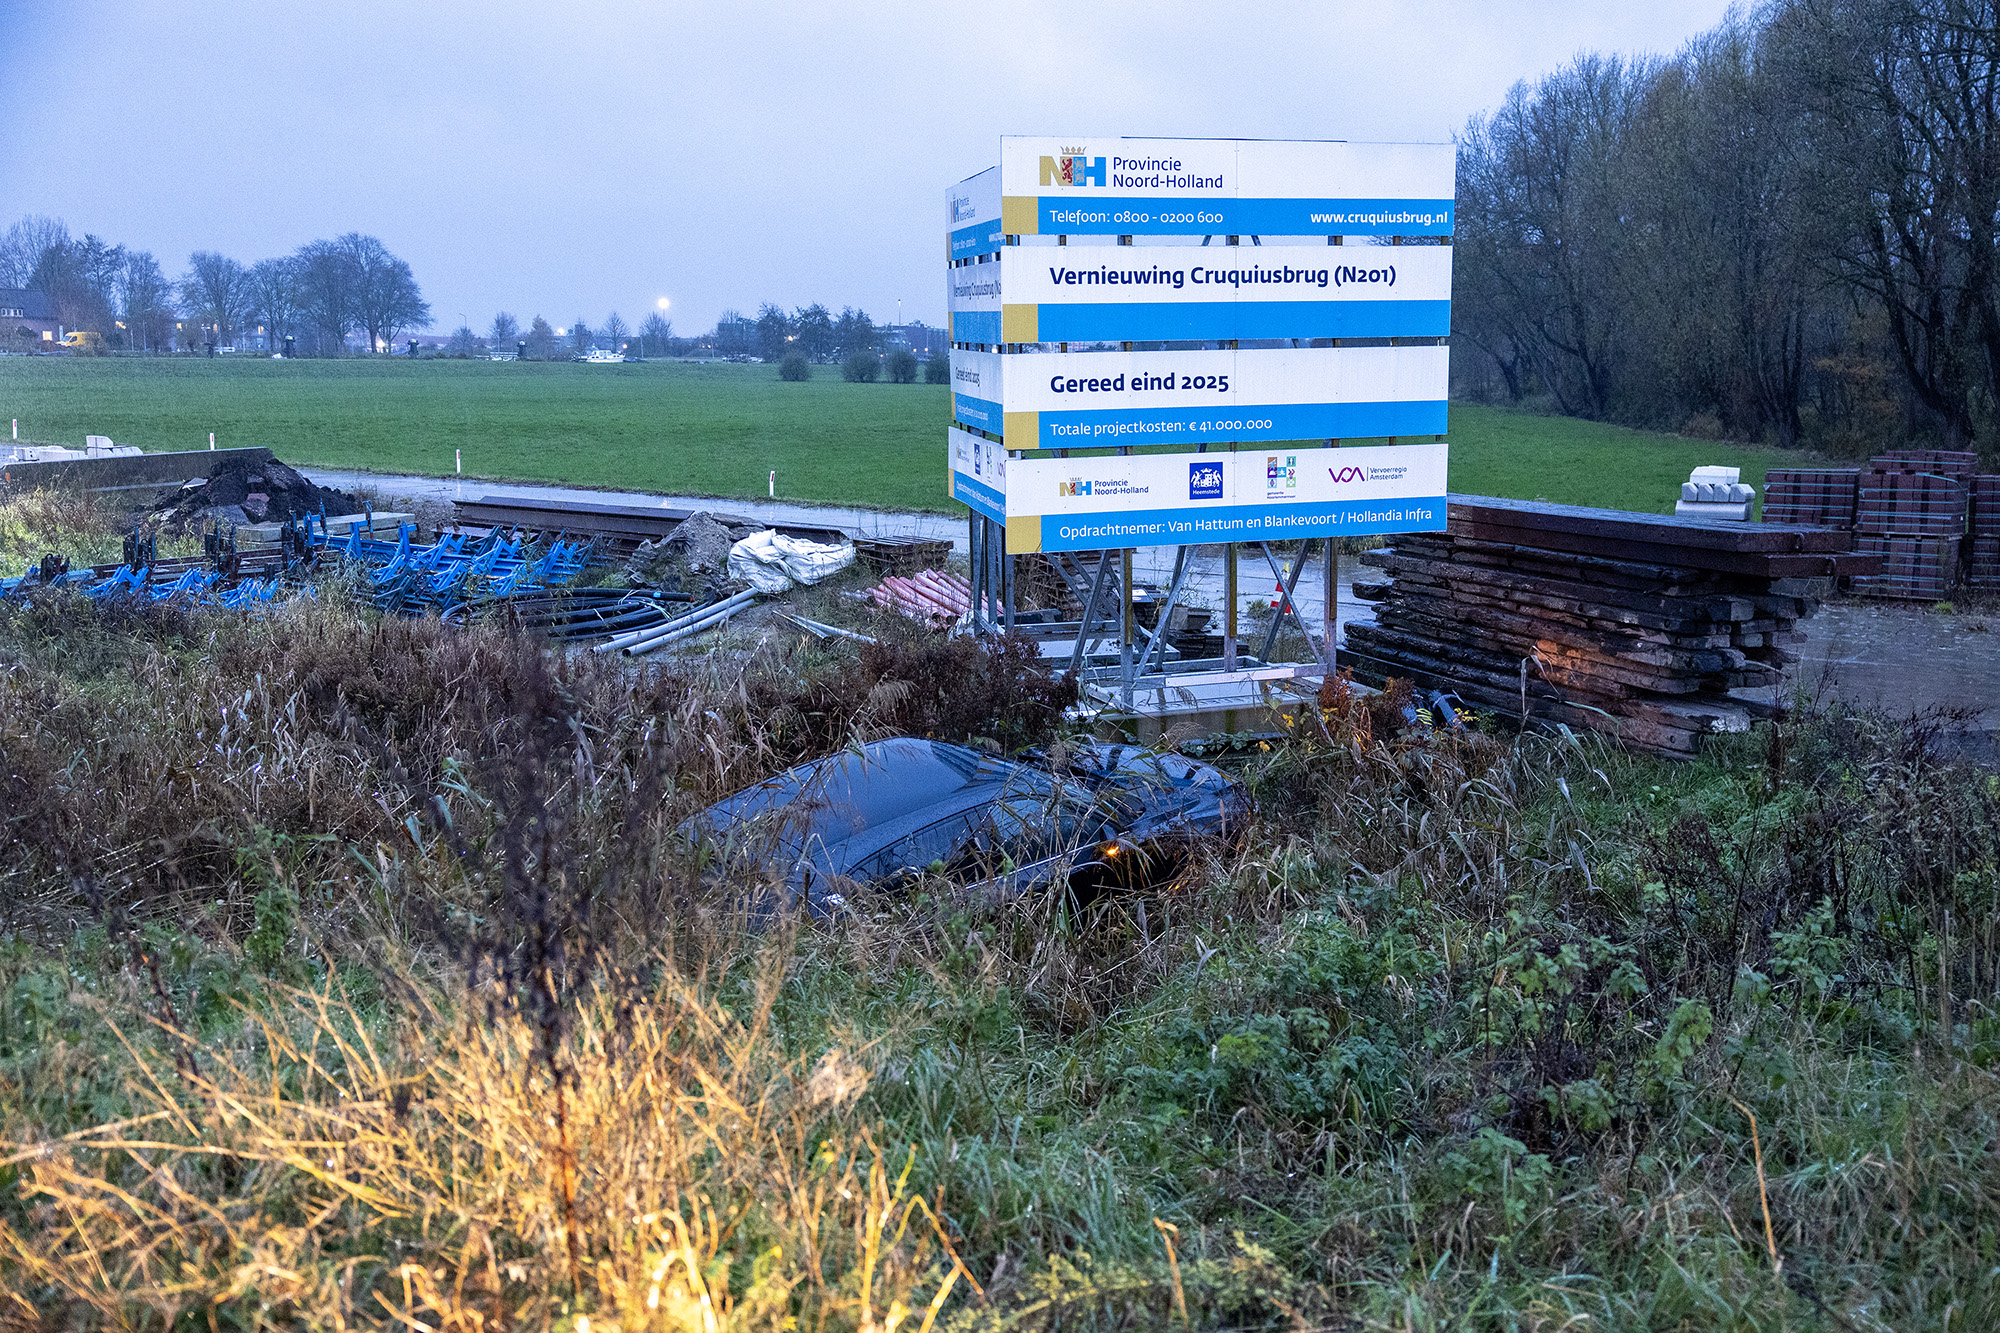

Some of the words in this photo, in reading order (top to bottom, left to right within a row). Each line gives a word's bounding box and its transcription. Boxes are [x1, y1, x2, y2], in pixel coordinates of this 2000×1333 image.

[1114, 156, 1181, 171] Provincie
[1113, 174, 1222, 188] Noord-Holland
[1050, 210, 1109, 225] Telefoon:
[1114, 211, 1149, 222] 0800
[1161, 213, 1194, 223] 0200
[1198, 211, 1223, 223] 600
[1311, 210, 1448, 226] www.cruquiusbrug.nl
[1050, 265, 1184, 288] Vernieuwing
[1190, 265, 1328, 288] Cruquiusbrug
[1335, 265, 1396, 287] (N201)
[1050, 374, 1125, 393] Gereed
[1131, 372, 1175, 391] eind
[1182, 375, 1229, 392] 2025
[1050, 423, 1090, 436] Totale
[1095, 421, 1185, 438] projectkosten:
[1189, 422, 1196, 431] €
[1200, 420, 1273, 432] 41.000.000
[1370, 466, 1408, 475] Vervoerregio
[1095, 479, 1129, 488] Provincie
[1095, 486, 1148, 495] Noord-Holland
[1060, 524, 1166, 540] Opdrachtnemer:
[1168, 521, 1191, 532] Van
[1196, 519, 1244, 531] Hattum
[1247, 519, 1262, 528] en
[1265, 514, 1337, 528] Blankevoort
[1340, 512, 1345, 524] /
[1348, 510, 1403, 522] Hollandia
[1406, 508, 1432, 522] Infra
